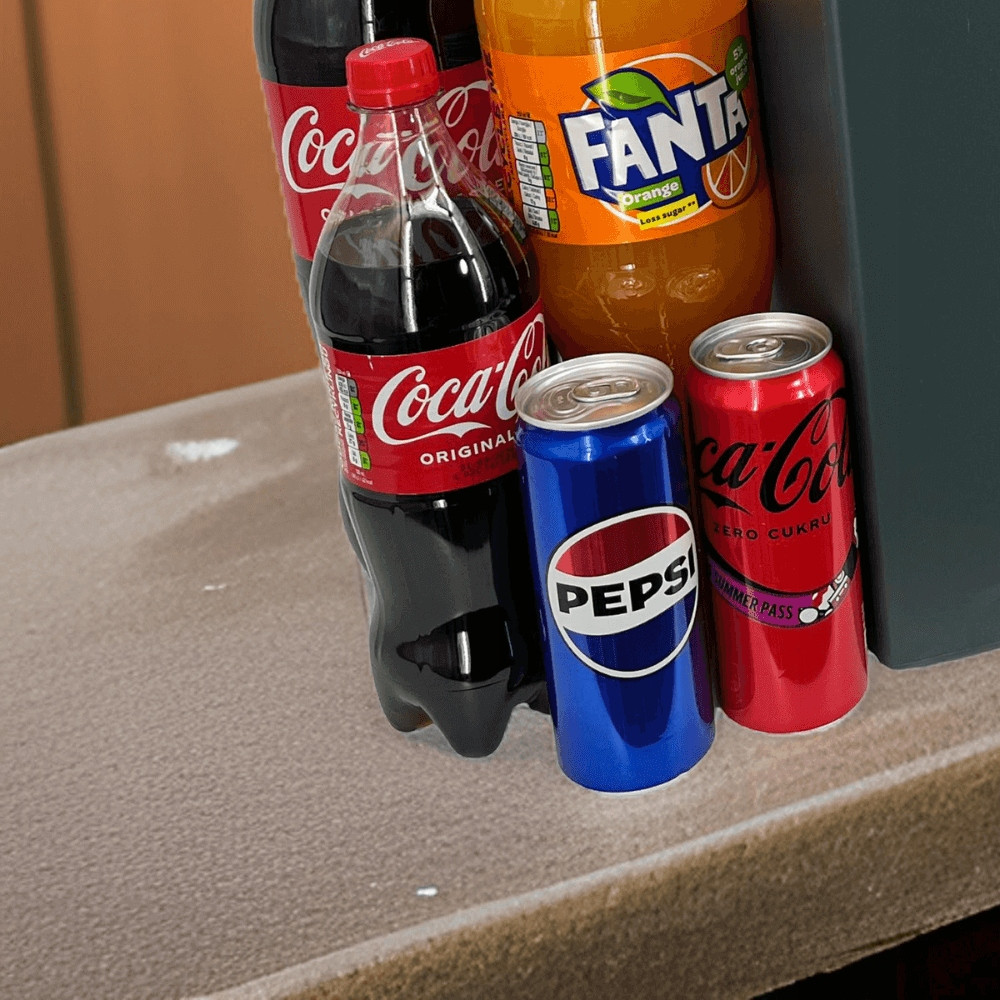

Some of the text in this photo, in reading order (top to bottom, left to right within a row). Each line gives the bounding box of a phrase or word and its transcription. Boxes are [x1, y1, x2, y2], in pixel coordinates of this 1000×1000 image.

[564, 77, 748, 191] FANTA
[622, 182, 679, 206] Orange
[662, 205, 686, 219] sugar
[372, 313, 546, 445] Coca-Co
[420, 431, 516, 466] ORIGINAL
[697, 388, 850, 513] ca-Col
[712, 514, 830, 540] ZERO CUKRU
[556, 542, 696, 617] PEPSI
[714, 571, 793, 620] SUMMER PASS
